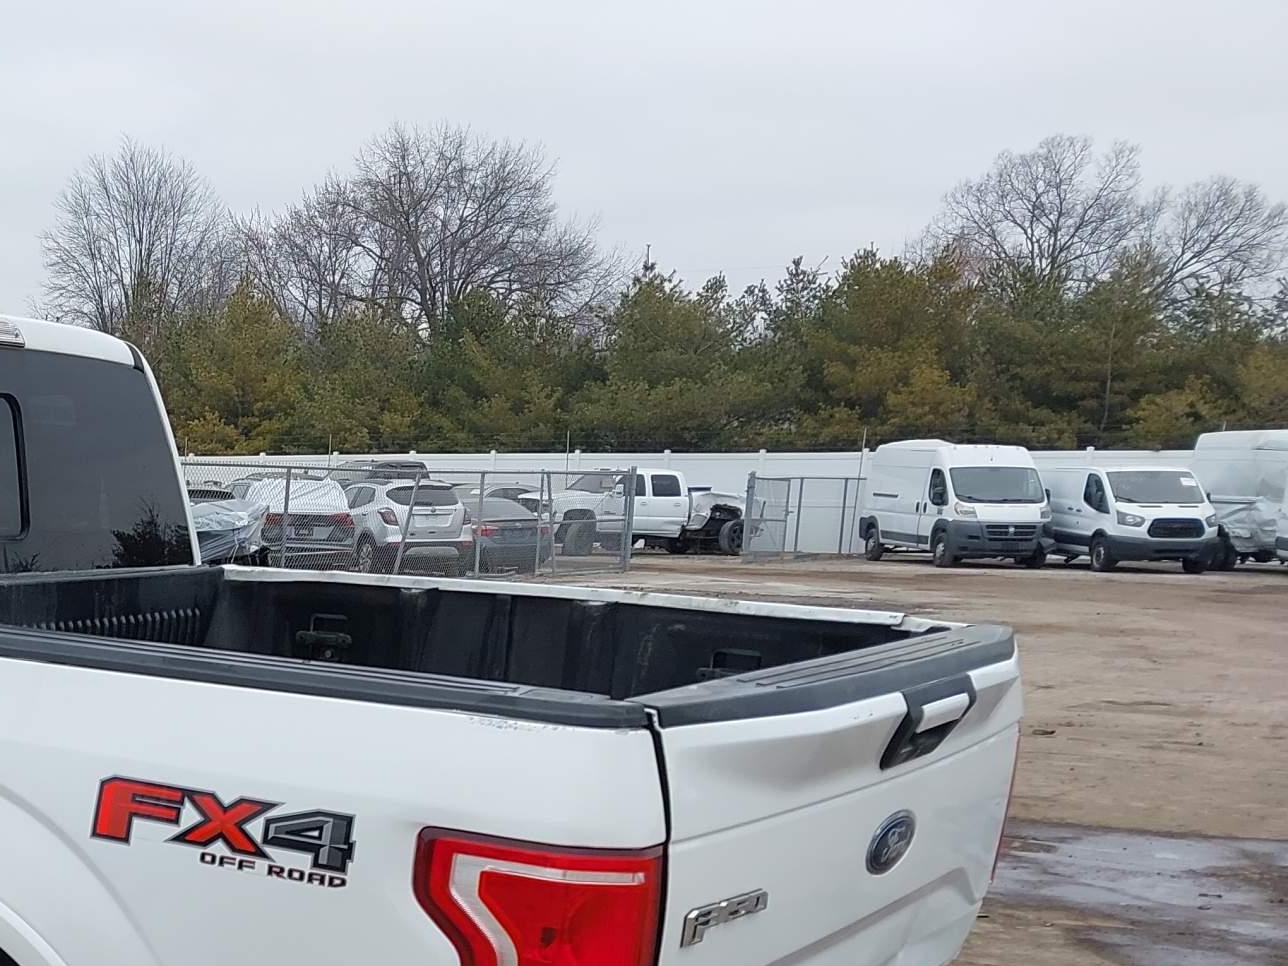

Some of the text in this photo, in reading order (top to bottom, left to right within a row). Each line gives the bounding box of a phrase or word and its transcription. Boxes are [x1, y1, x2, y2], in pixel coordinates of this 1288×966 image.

[90, 774, 357, 876] FX4
[199, 851, 348, 888] OFF ROAD
